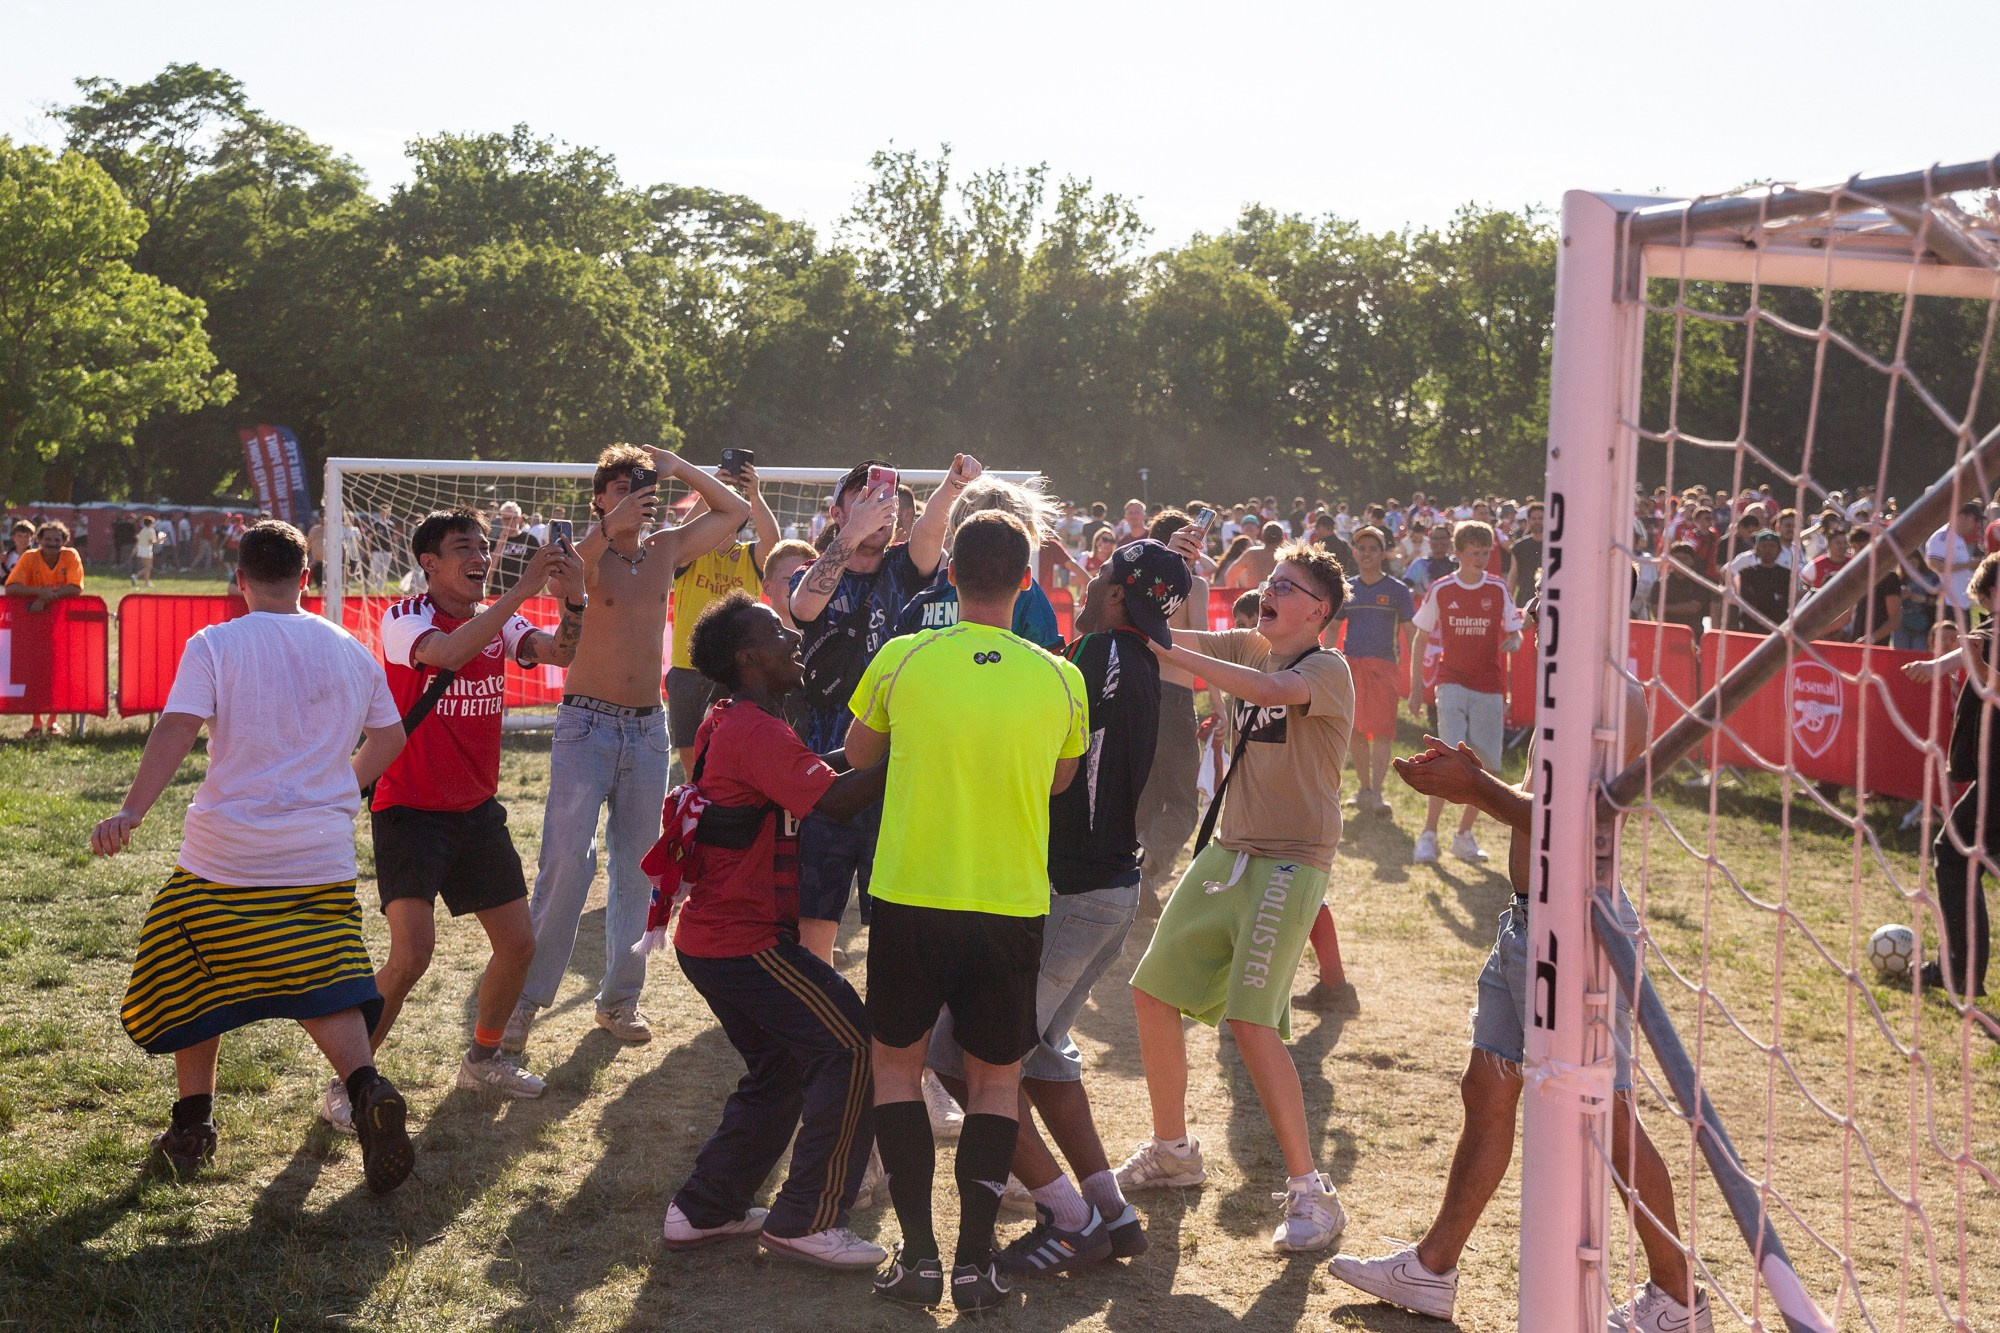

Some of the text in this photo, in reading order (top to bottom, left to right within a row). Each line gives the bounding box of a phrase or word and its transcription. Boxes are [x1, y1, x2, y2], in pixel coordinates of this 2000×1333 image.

[1793, 676, 1836, 696] Arsenal
[436, 696, 502, 717] FLY BETTER
[1242, 872, 1294, 989] HOLLISTER
